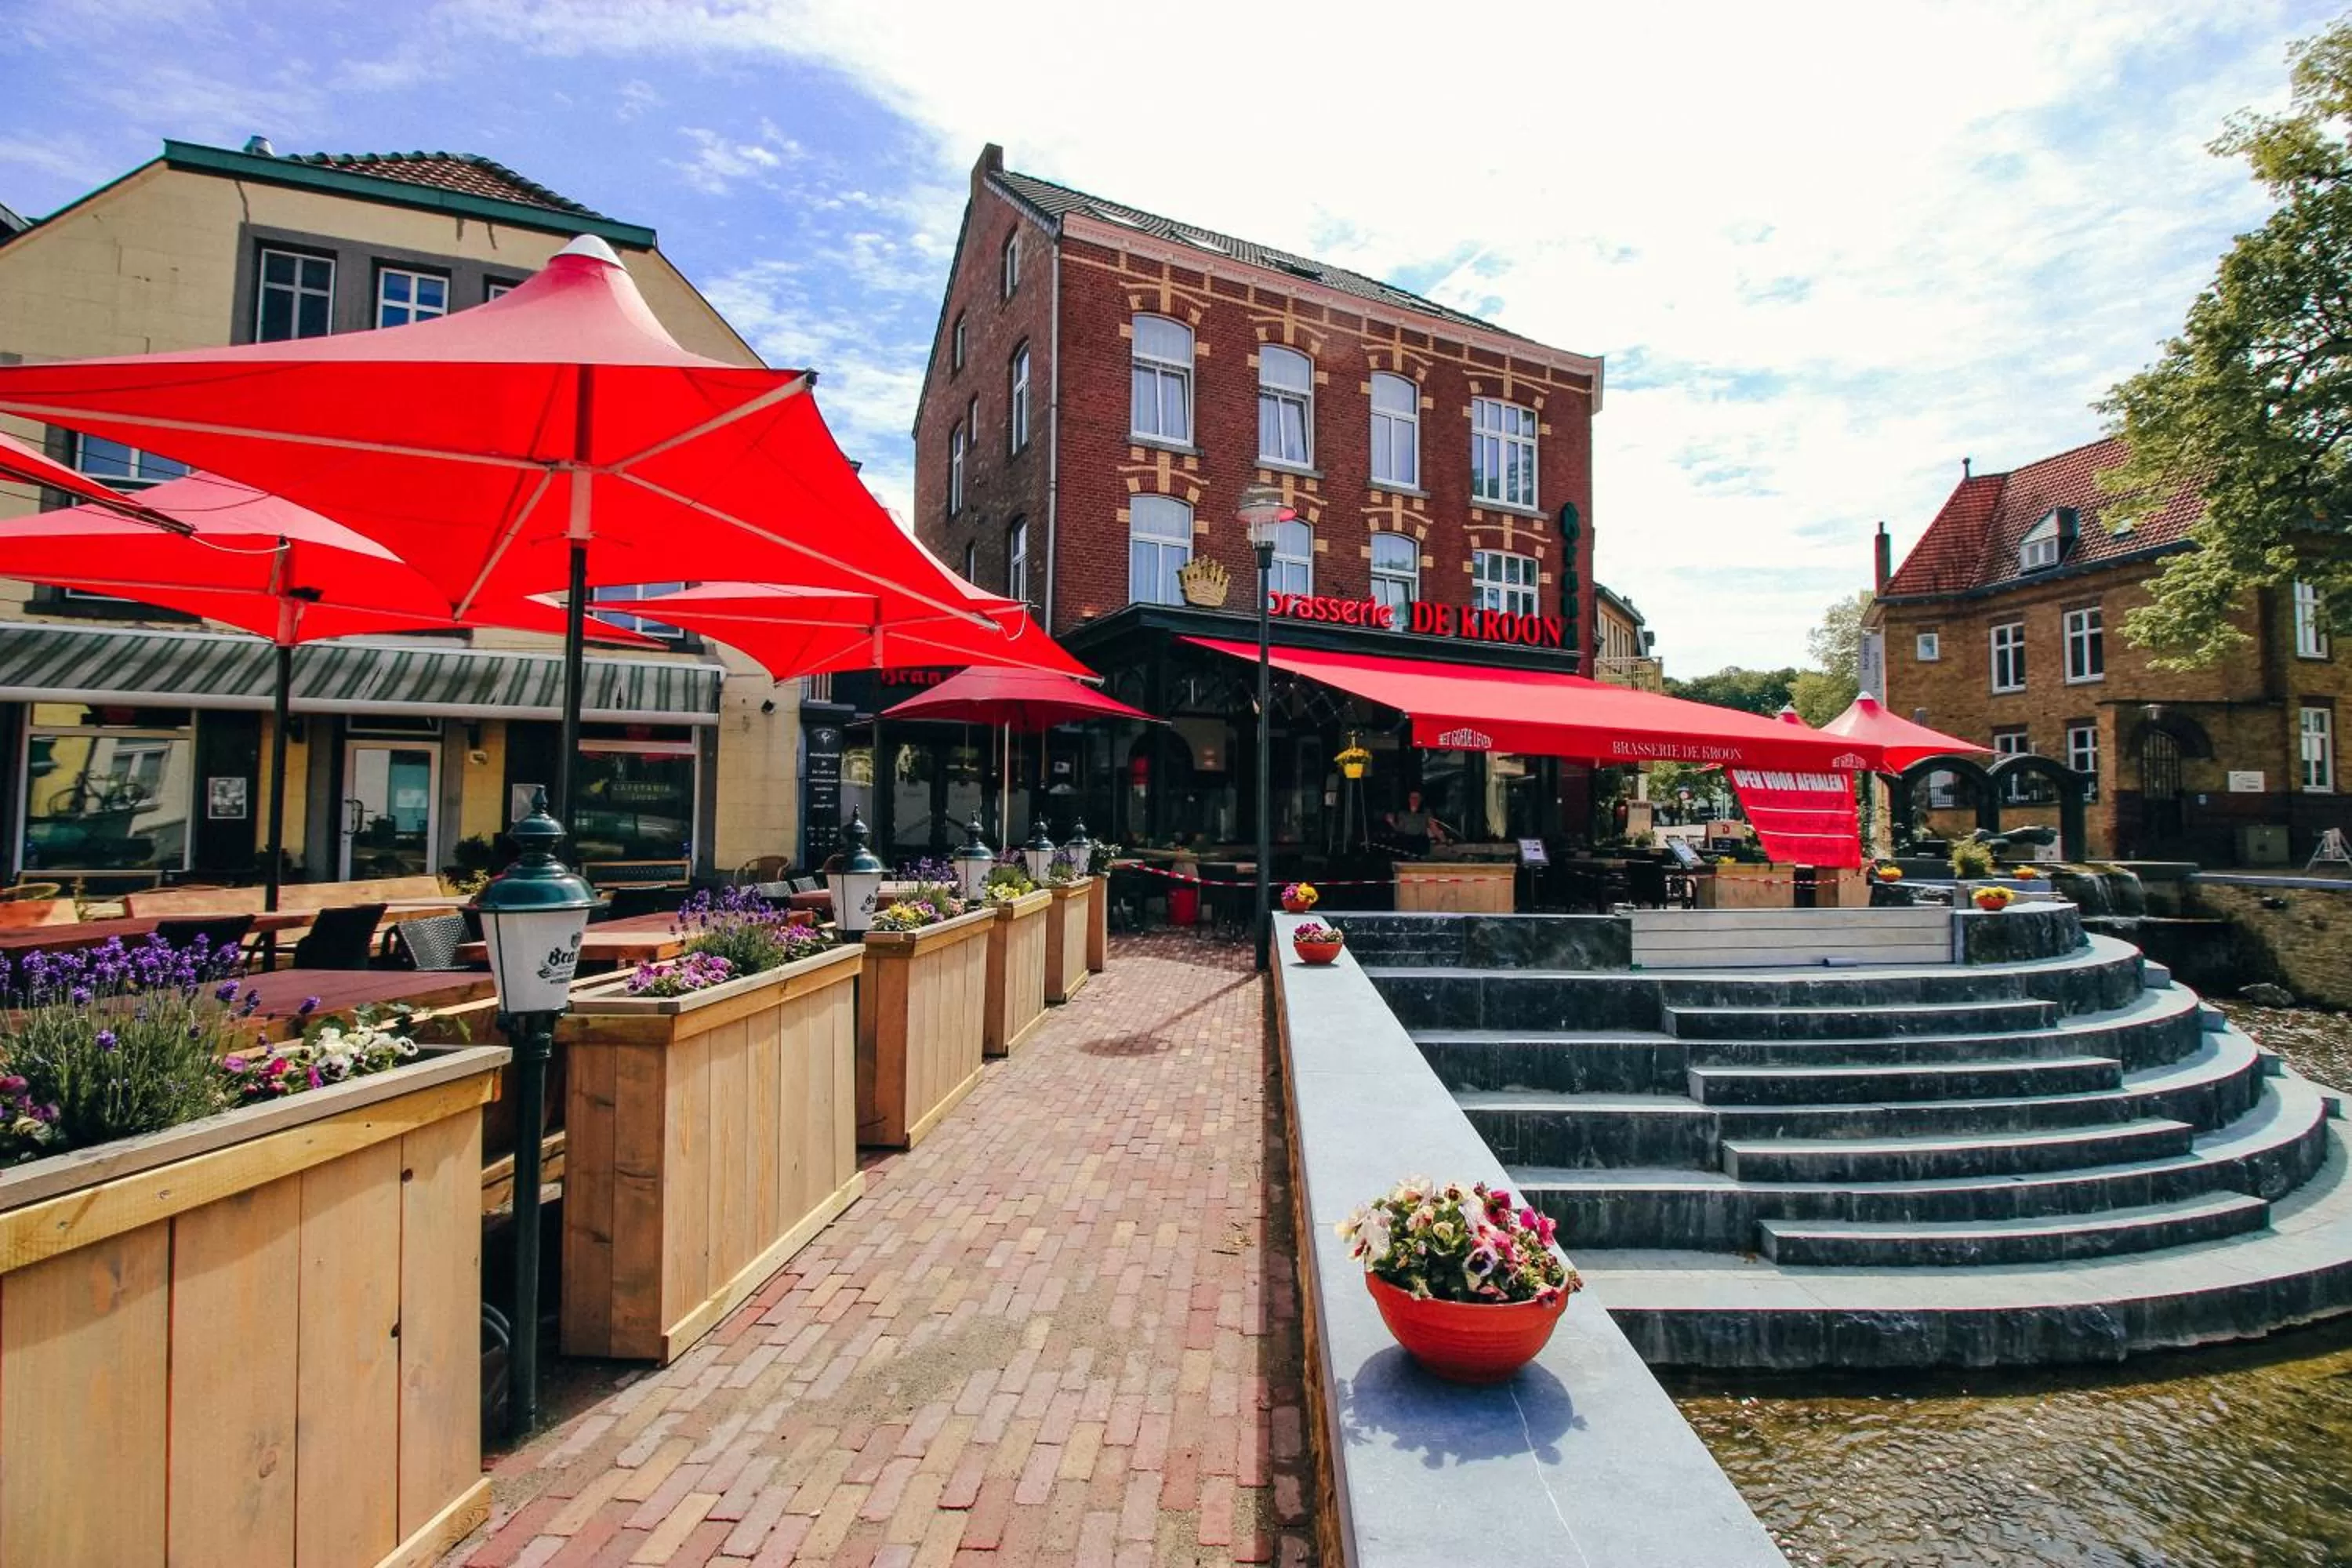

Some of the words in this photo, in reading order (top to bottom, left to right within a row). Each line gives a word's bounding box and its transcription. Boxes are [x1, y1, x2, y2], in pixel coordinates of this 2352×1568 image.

[1412, 601, 1453, 637] DE
[1460, 604, 1564, 648] KROON
[1613, 740, 1680, 757] BRASSERIE
[1683, 743, 1700, 759] DE
[1702, 746, 1743, 760] KROON
[1732, 769, 1766, 789] OPEN
[1762, 771, 1798, 791] VOOR
